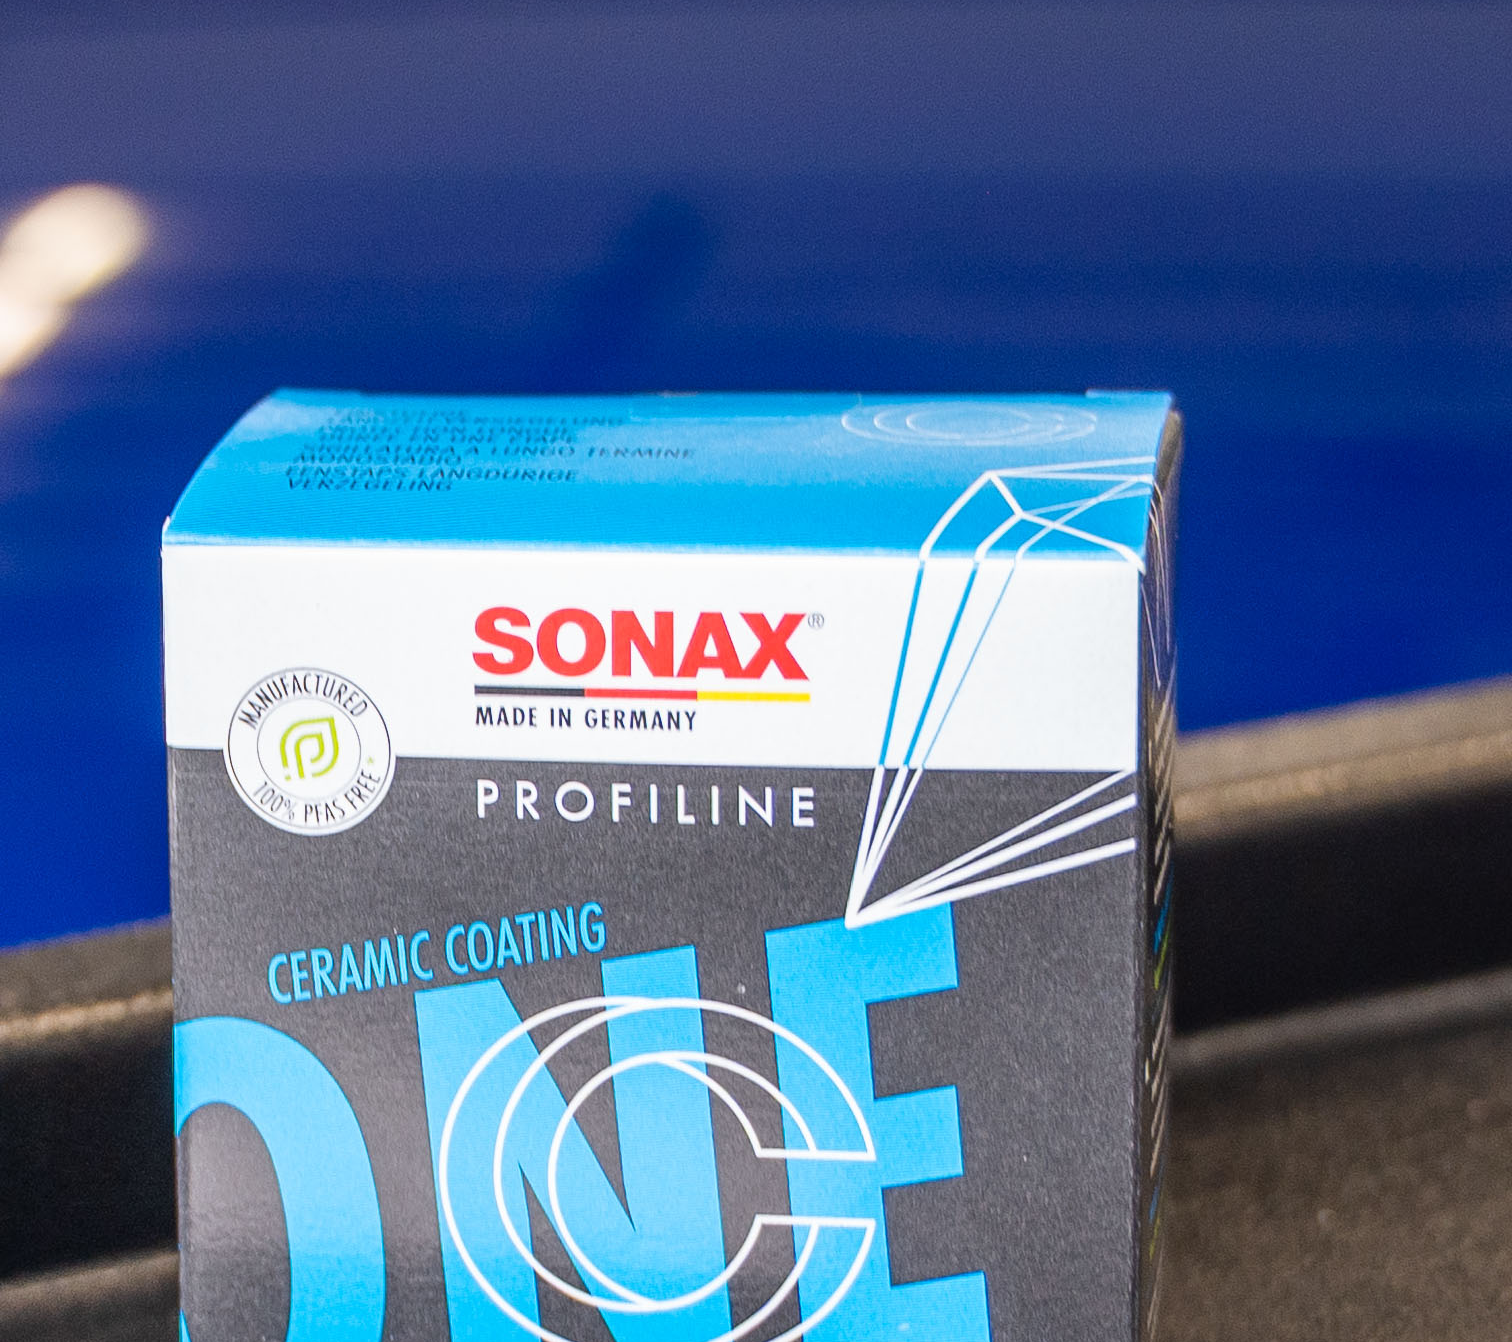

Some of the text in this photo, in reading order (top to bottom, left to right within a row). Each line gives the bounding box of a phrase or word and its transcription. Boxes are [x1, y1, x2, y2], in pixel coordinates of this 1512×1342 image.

[588, 445, 695, 459] TERMINE
[287, 477, 452, 492] VERZEGELING
[472, 606, 810, 681] SONAX
[238, 673, 368, 730] MANUFACTURED
[475, 706, 697, 731] MADE IN GERMANY
[252, 769, 381, 824] 100% PFAS FREE
[476, 778, 816, 827] PROFILINE
[268, 901, 608, 1004] CERAMIC COATING
